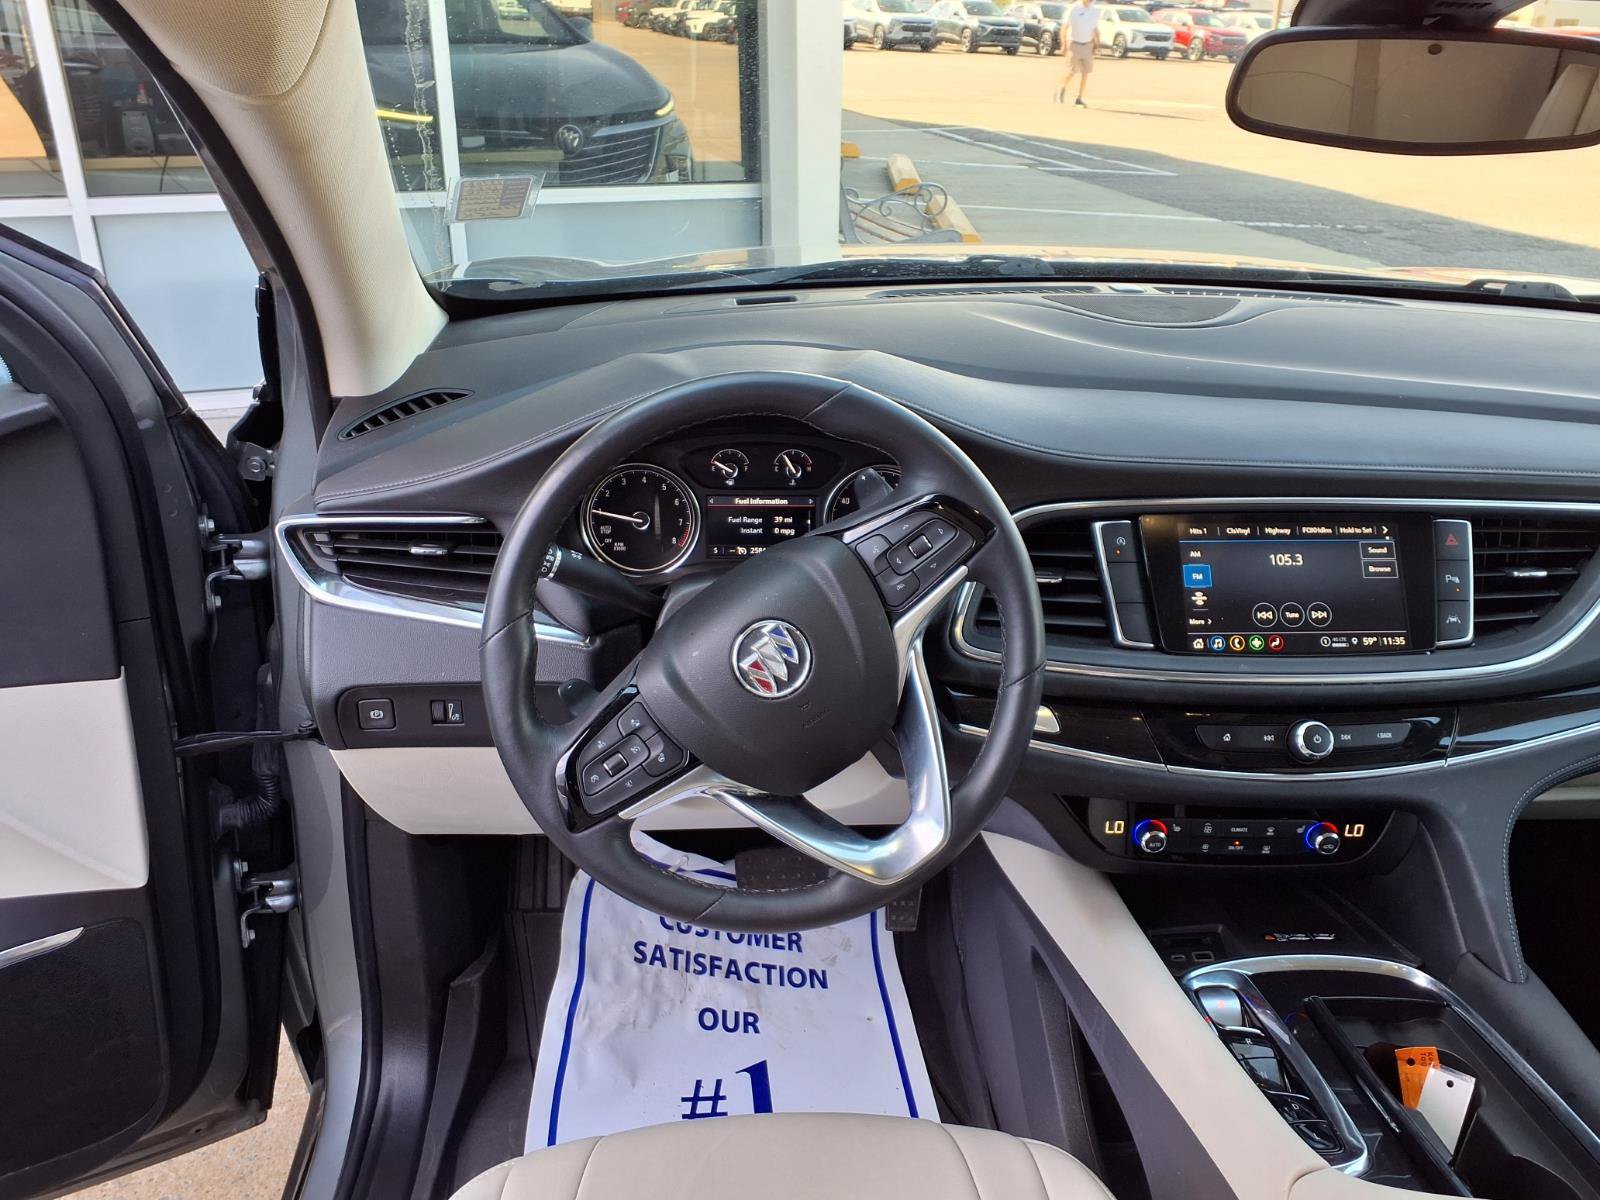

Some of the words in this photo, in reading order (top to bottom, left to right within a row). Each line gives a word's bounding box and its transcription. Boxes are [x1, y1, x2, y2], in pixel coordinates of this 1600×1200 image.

[621, 478, 627, 486] 3
[661, 483, 667, 491] 5
[605, 489, 610, 497] 2
[674, 498, 680, 506] 6
[841, 497, 850, 505] 40
[678, 518, 683, 526] 7
[743, 516, 763, 525] Range
[780, 528, 795, 536] mpg
[1265, 527, 1291, 536] Highway
[1340, 526, 1355, 534] Hold
[1362, 526, 1373, 534] Set
[1190, 550, 1202, 558] AM
[1368, 546, 1388, 554] Sound
[1269, 553, 1304, 566] 105.3
[1368, 565, 1392, 573] Browse
[1192, 572, 1204, 580] FM
[1382, 636, 1406, 646] 11:35
[1105, 820, 1125, 834] LO
[1344, 823, 1365, 838] LO
[633, 939, 829, 990] SATISFACTION
[698, 1006, 760, 1034] OUR
